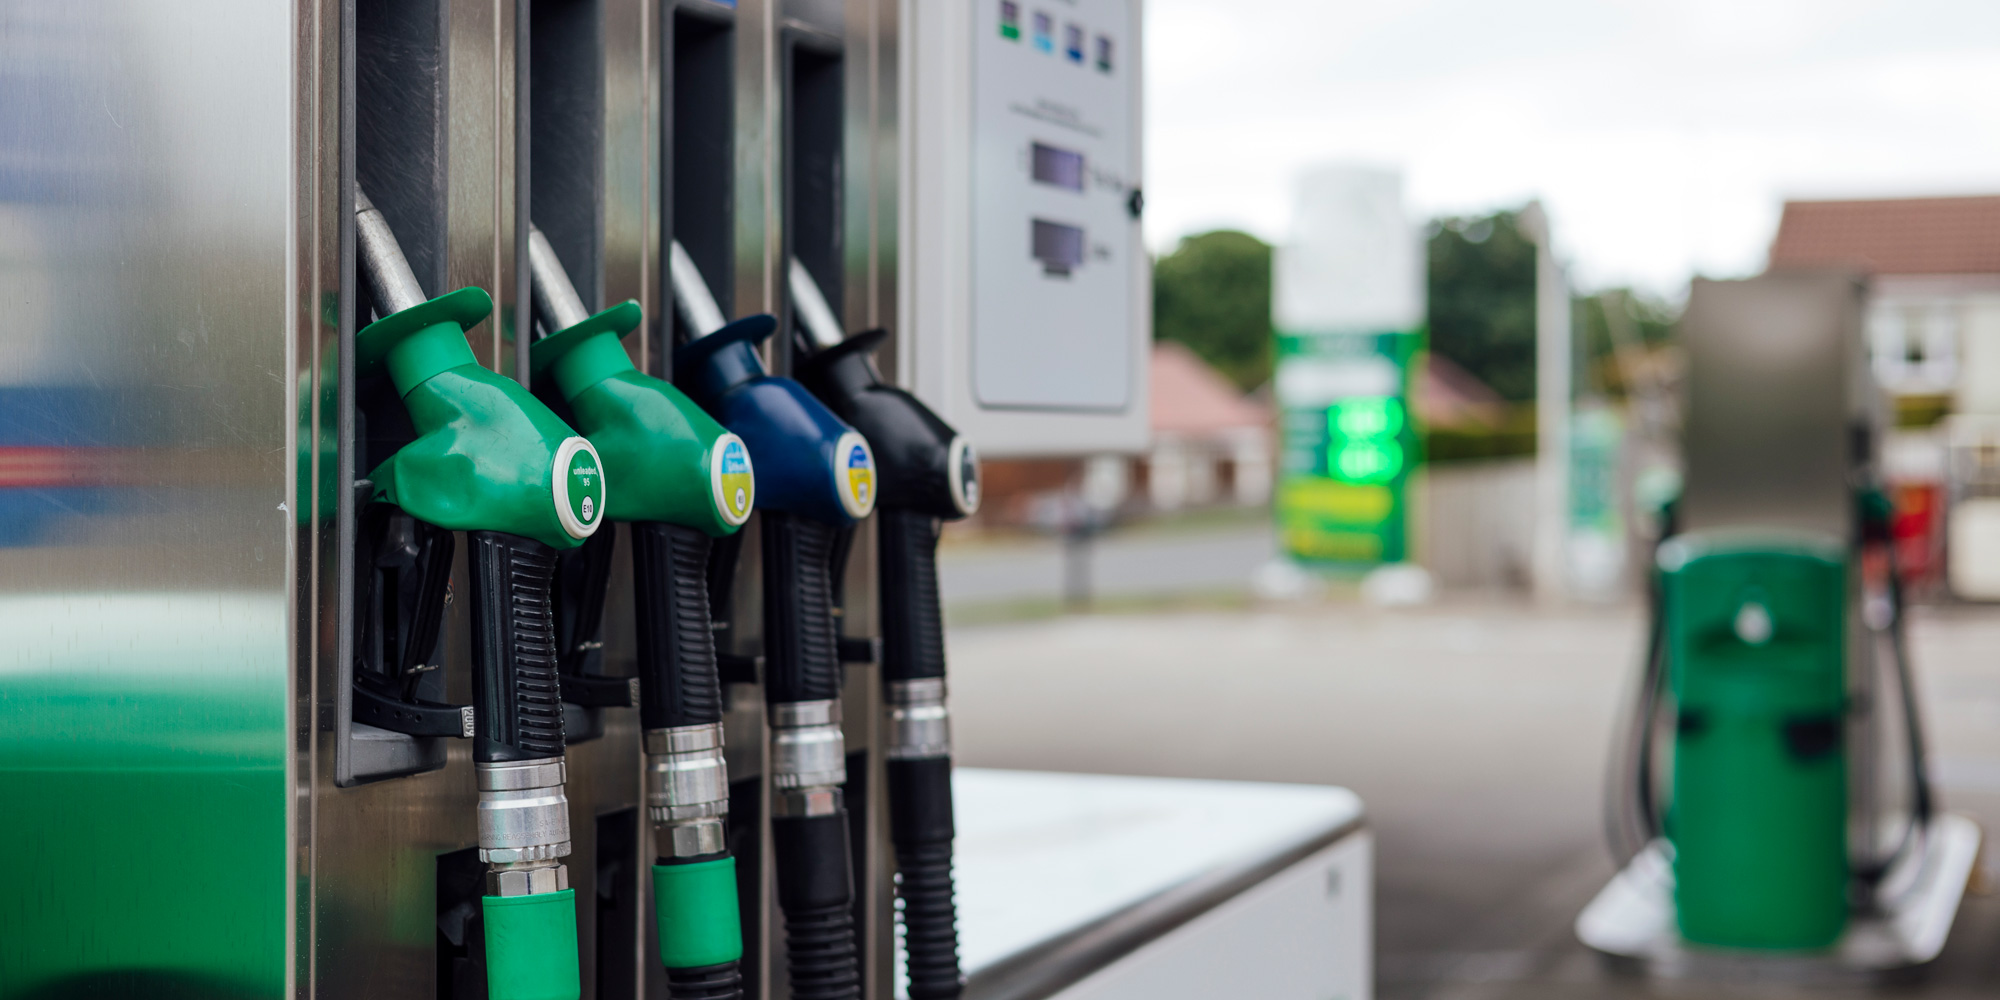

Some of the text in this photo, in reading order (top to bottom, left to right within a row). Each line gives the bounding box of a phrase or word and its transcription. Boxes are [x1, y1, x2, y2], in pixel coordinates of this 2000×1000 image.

[573, 467, 597, 475] unleaded
[583, 477, 590, 487] 95
[583, 504, 592, 513] E10
[465, 709, 474, 736] 2009
